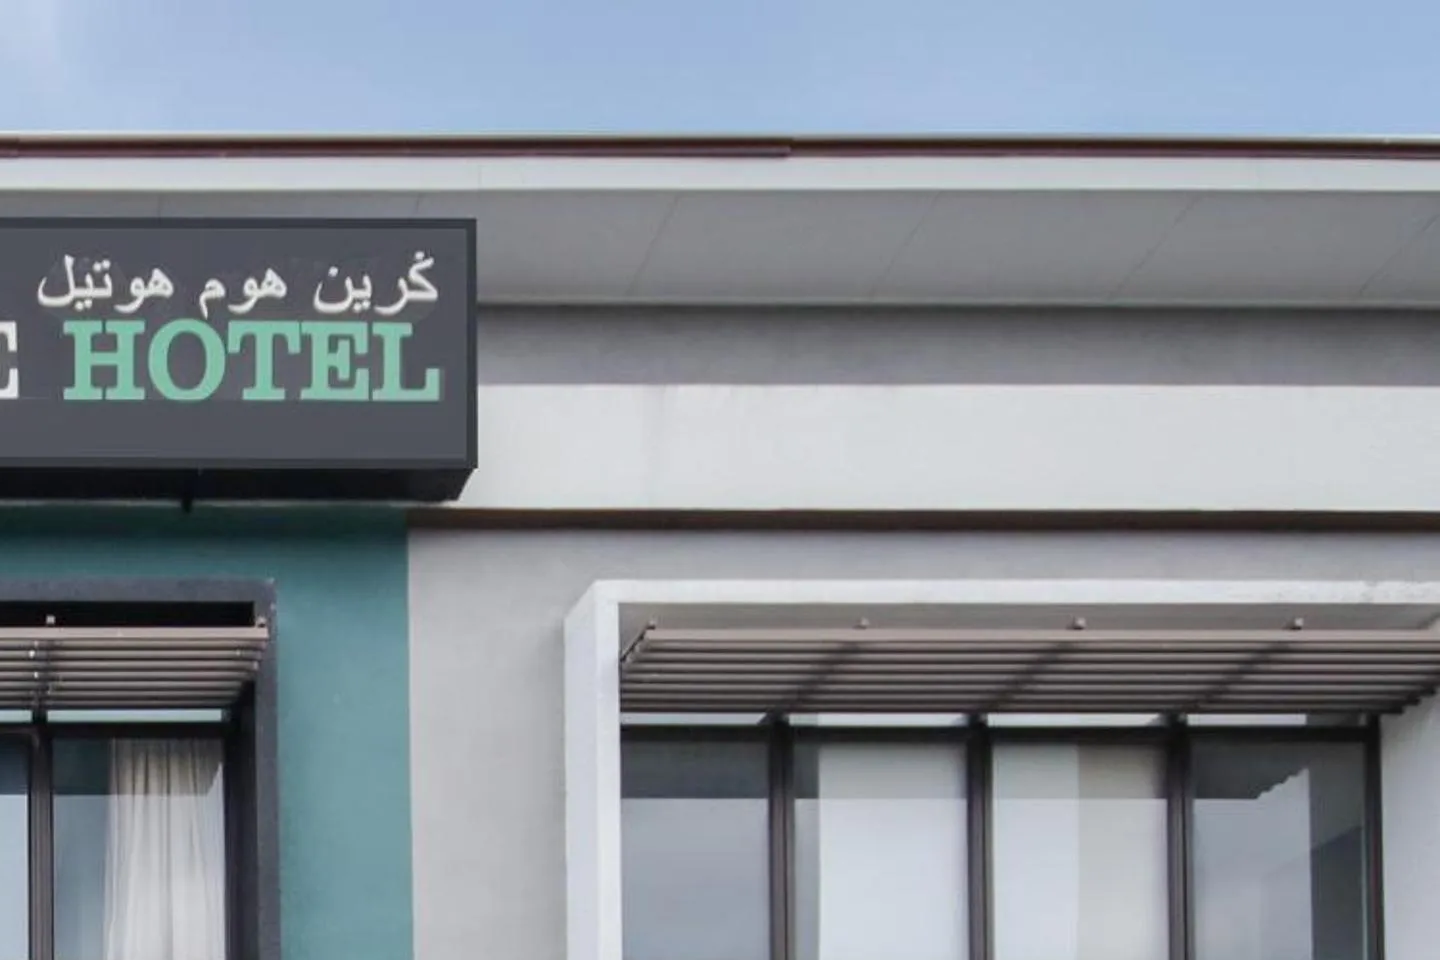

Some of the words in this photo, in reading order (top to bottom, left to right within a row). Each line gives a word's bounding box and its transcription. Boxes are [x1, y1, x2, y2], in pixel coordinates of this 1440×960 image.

[37, 254, 174, 314] هوتيل
[199, 267, 287, 320] هوم
[62, 319, 440, 402] HOTEL
